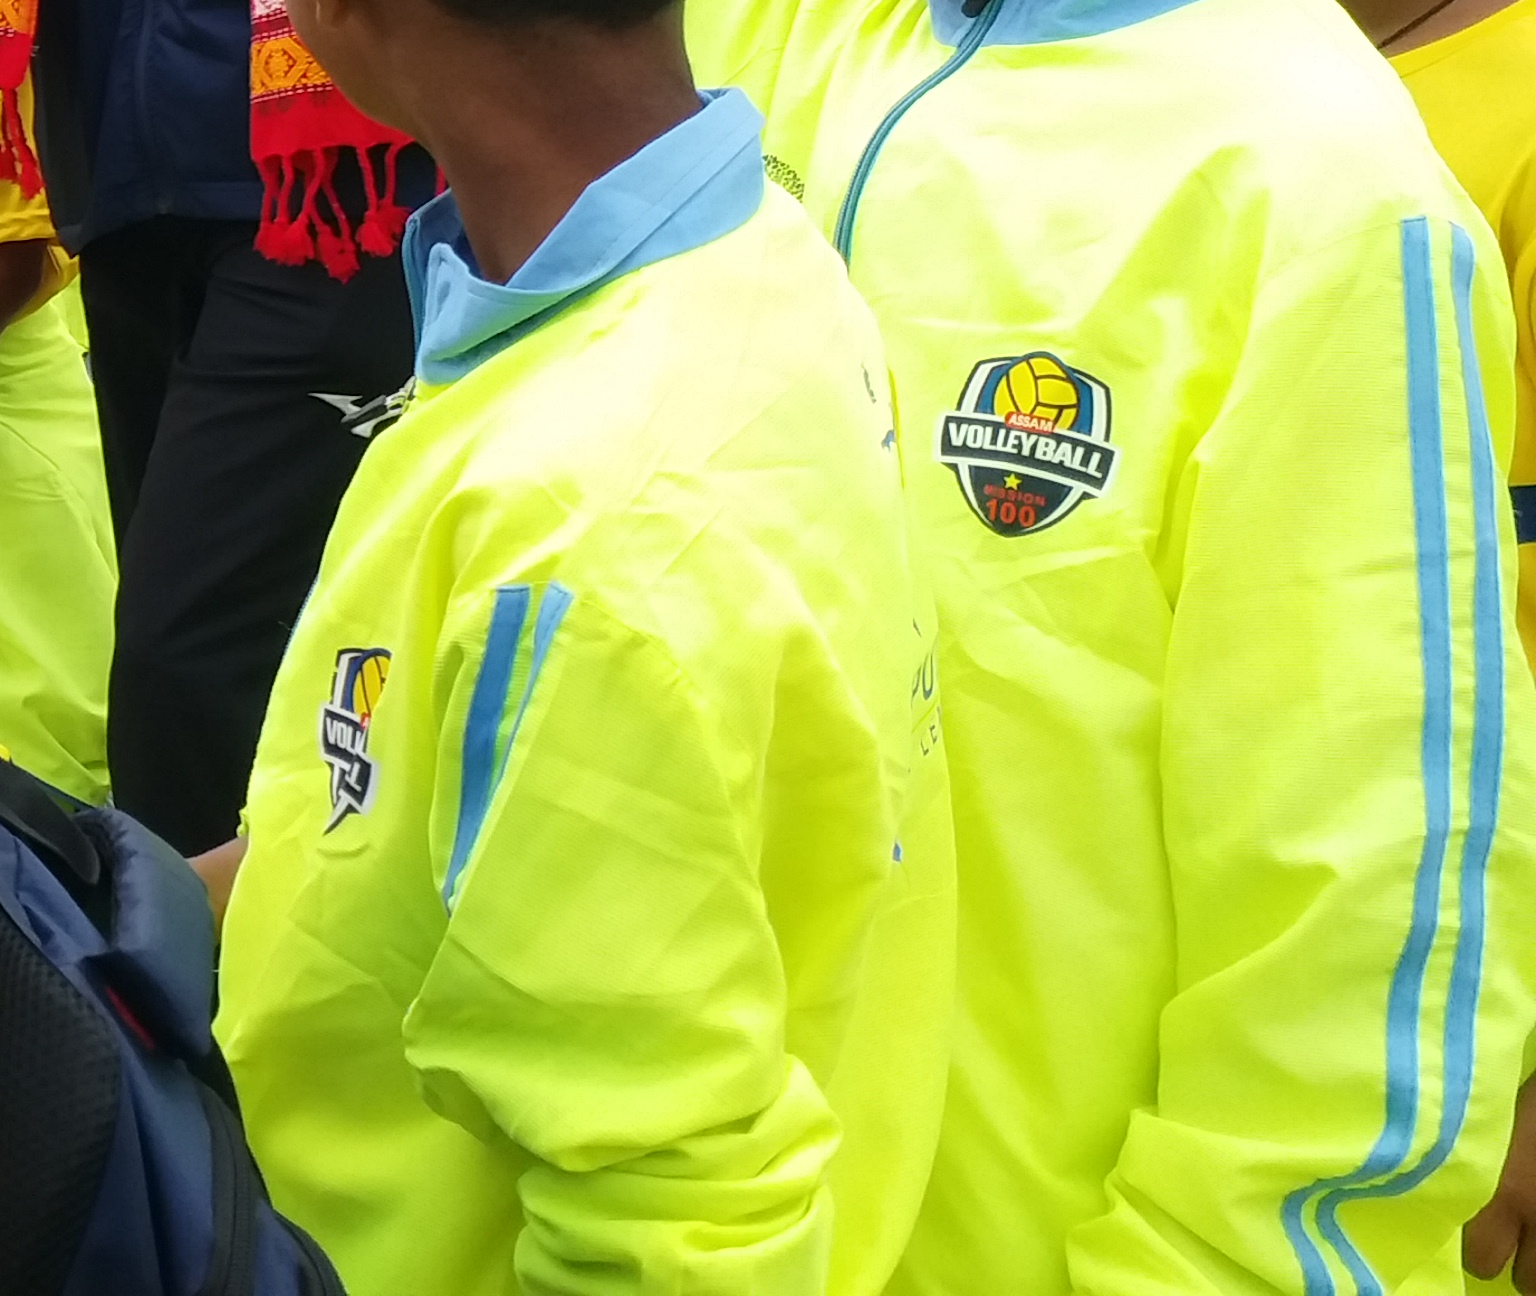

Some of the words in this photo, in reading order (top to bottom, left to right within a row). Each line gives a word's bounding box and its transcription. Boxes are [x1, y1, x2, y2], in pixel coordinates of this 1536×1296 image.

[1008, 414, 1054, 433] ASSAM
[947, 421, 1104, 479] VOLLEYBALL
[983, 484, 1047, 507] MISSION
[986, 498, 1037, 528] 100
